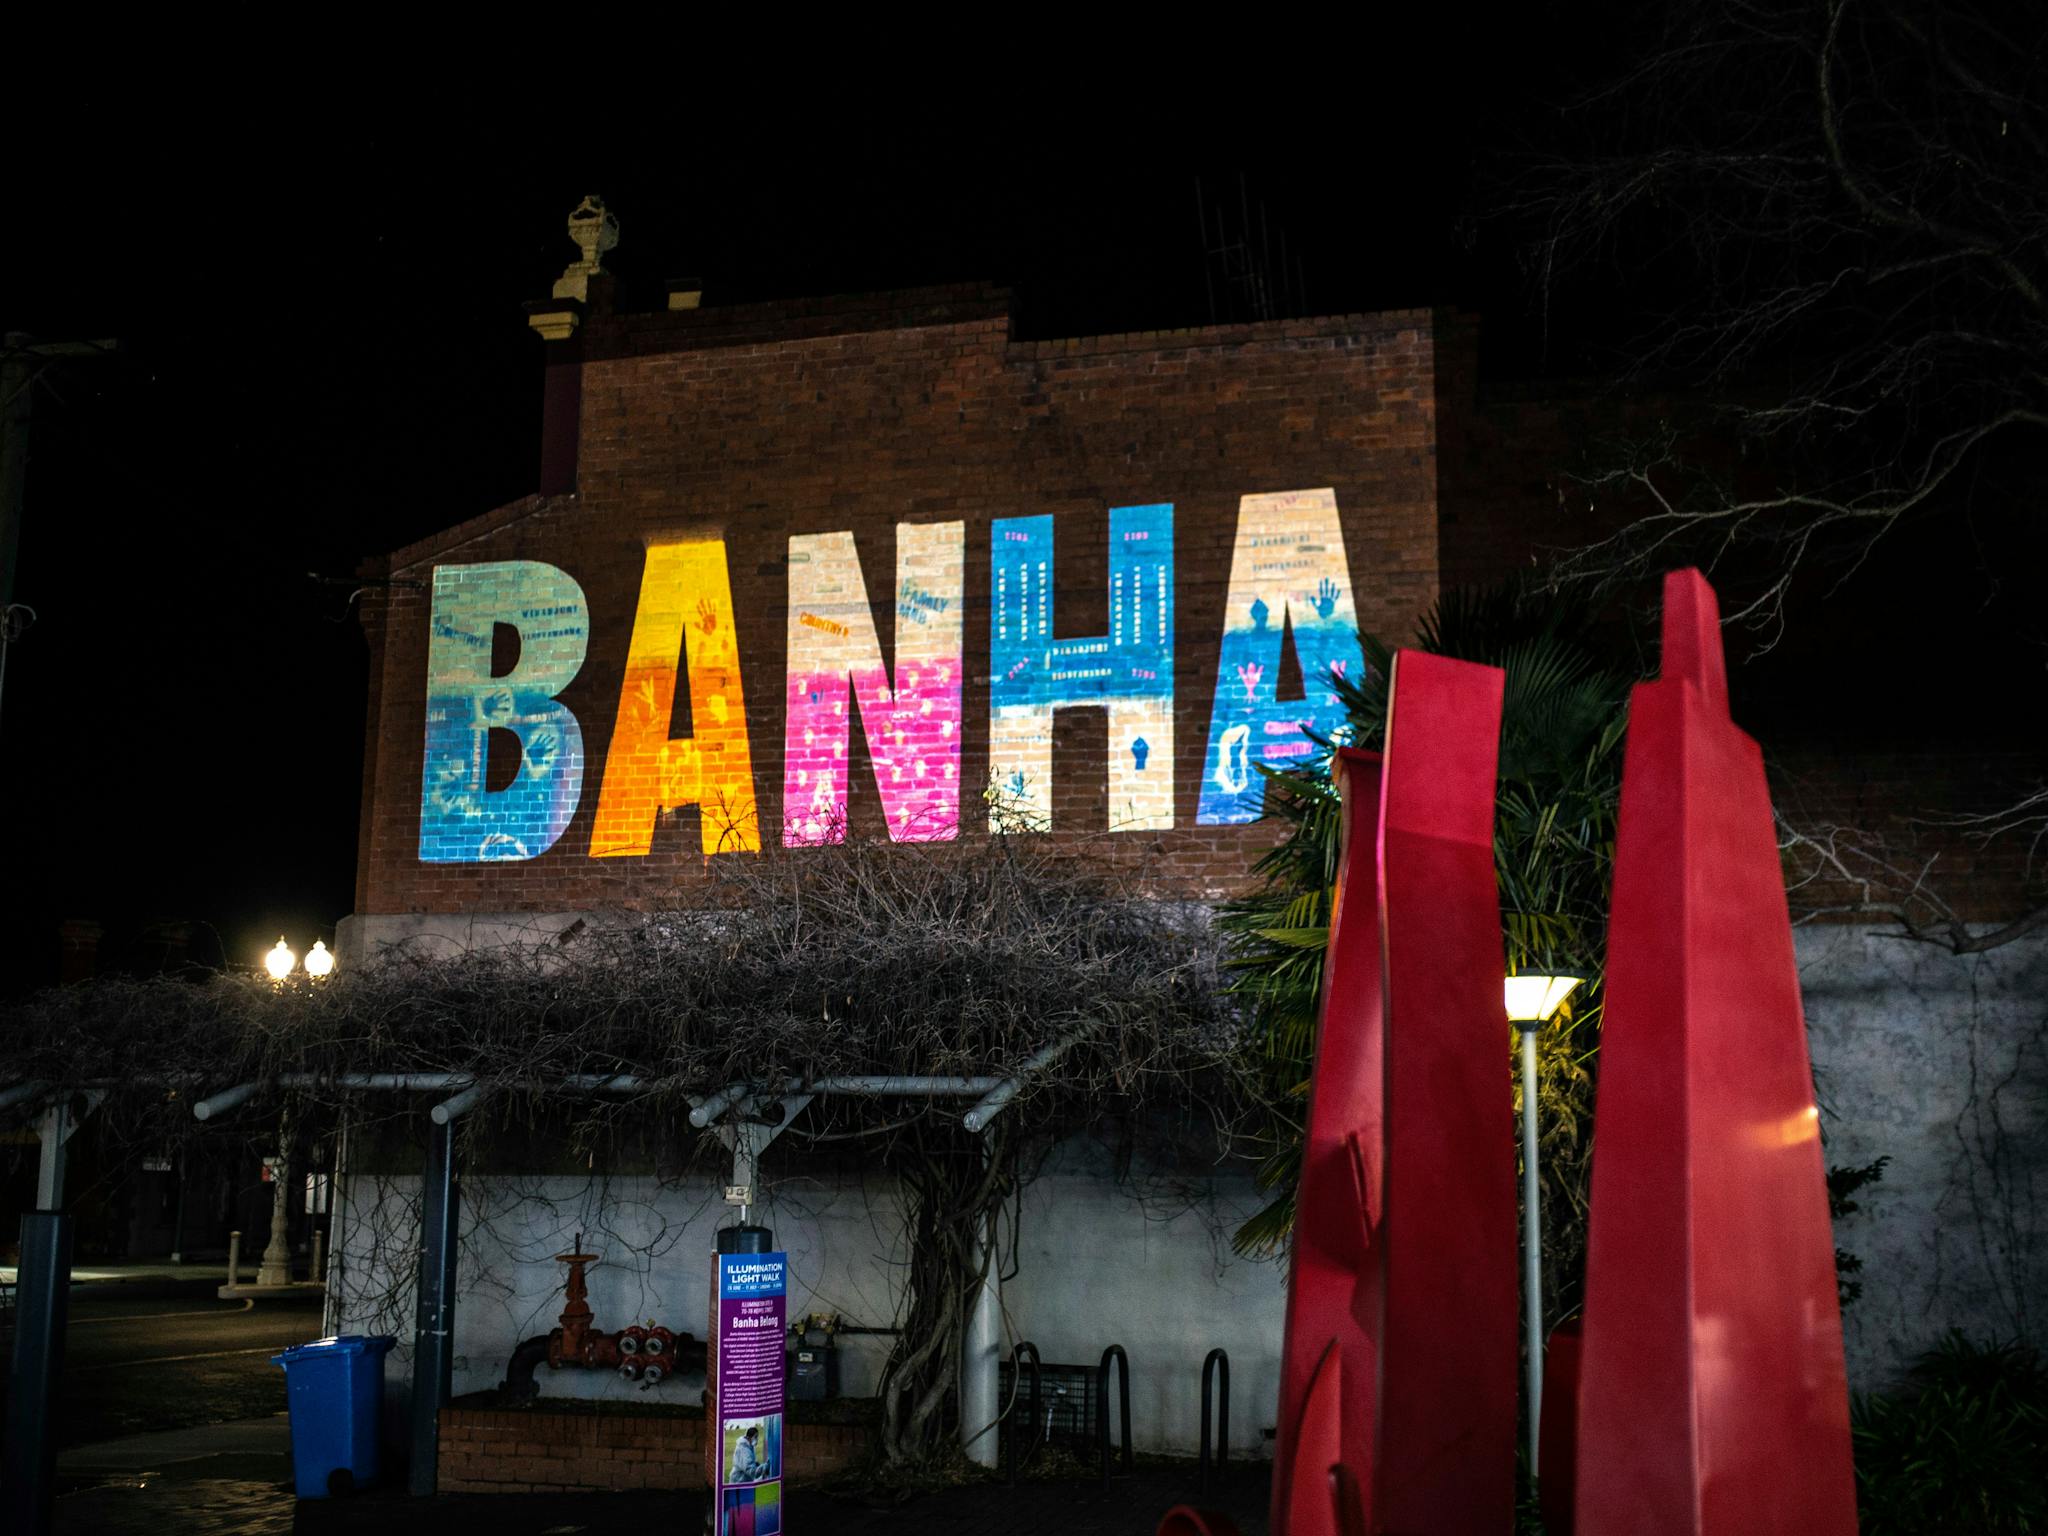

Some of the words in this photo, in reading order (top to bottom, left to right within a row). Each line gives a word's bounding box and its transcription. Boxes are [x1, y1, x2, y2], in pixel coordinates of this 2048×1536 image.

[418, 487, 1365, 864] BANHA
[728, 1263, 782, 1274] ILLUMINATION
[732, 1274, 760, 1283] LIGHT
[762, 1272, 779, 1282] WALK
[733, 1317, 758, 1328] Banha
[760, 1316, 778, 1327] Belong
